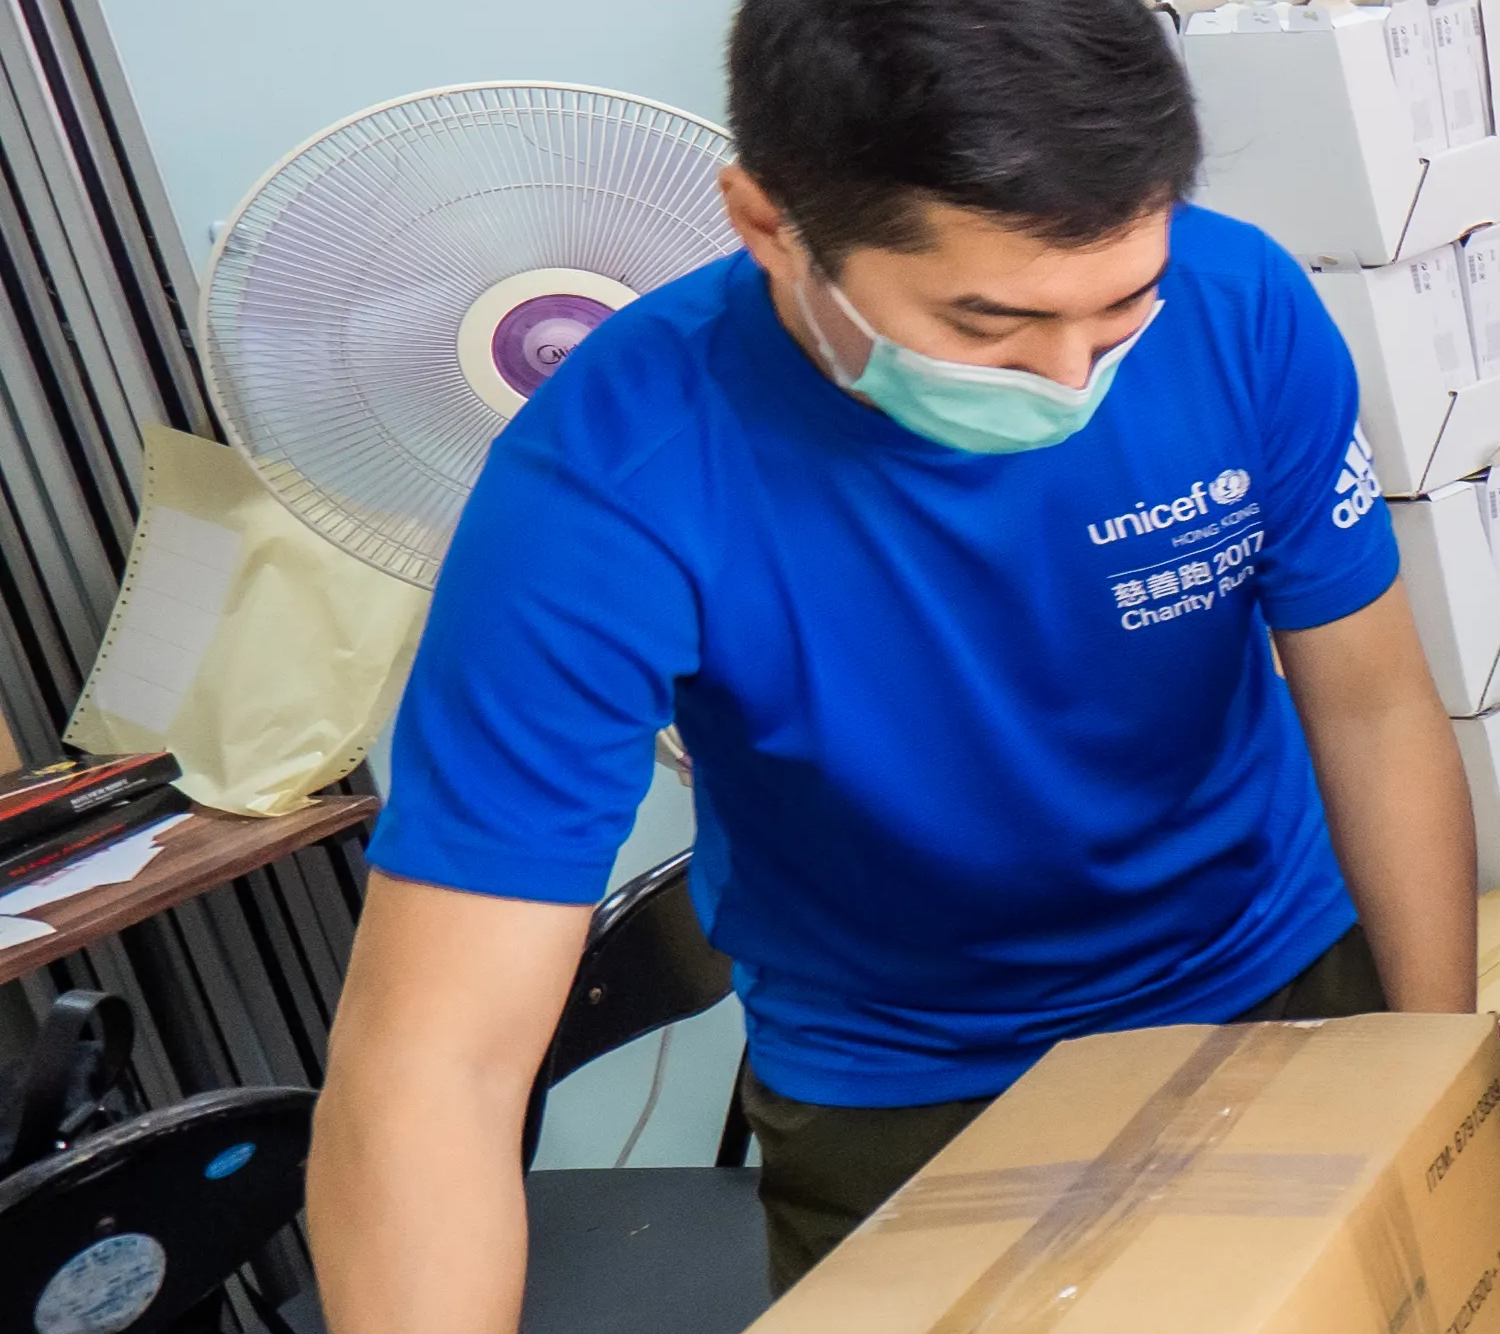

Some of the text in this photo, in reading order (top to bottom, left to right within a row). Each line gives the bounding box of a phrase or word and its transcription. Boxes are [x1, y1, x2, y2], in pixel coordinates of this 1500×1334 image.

[1087, 481, 1208, 546] unicef
[1113, 530, 1265, 609] 慈善跑 2017
[1120, 564, 1255, 631] Charity Run
[1425, 1145, 1455, 1194] ITEM:
